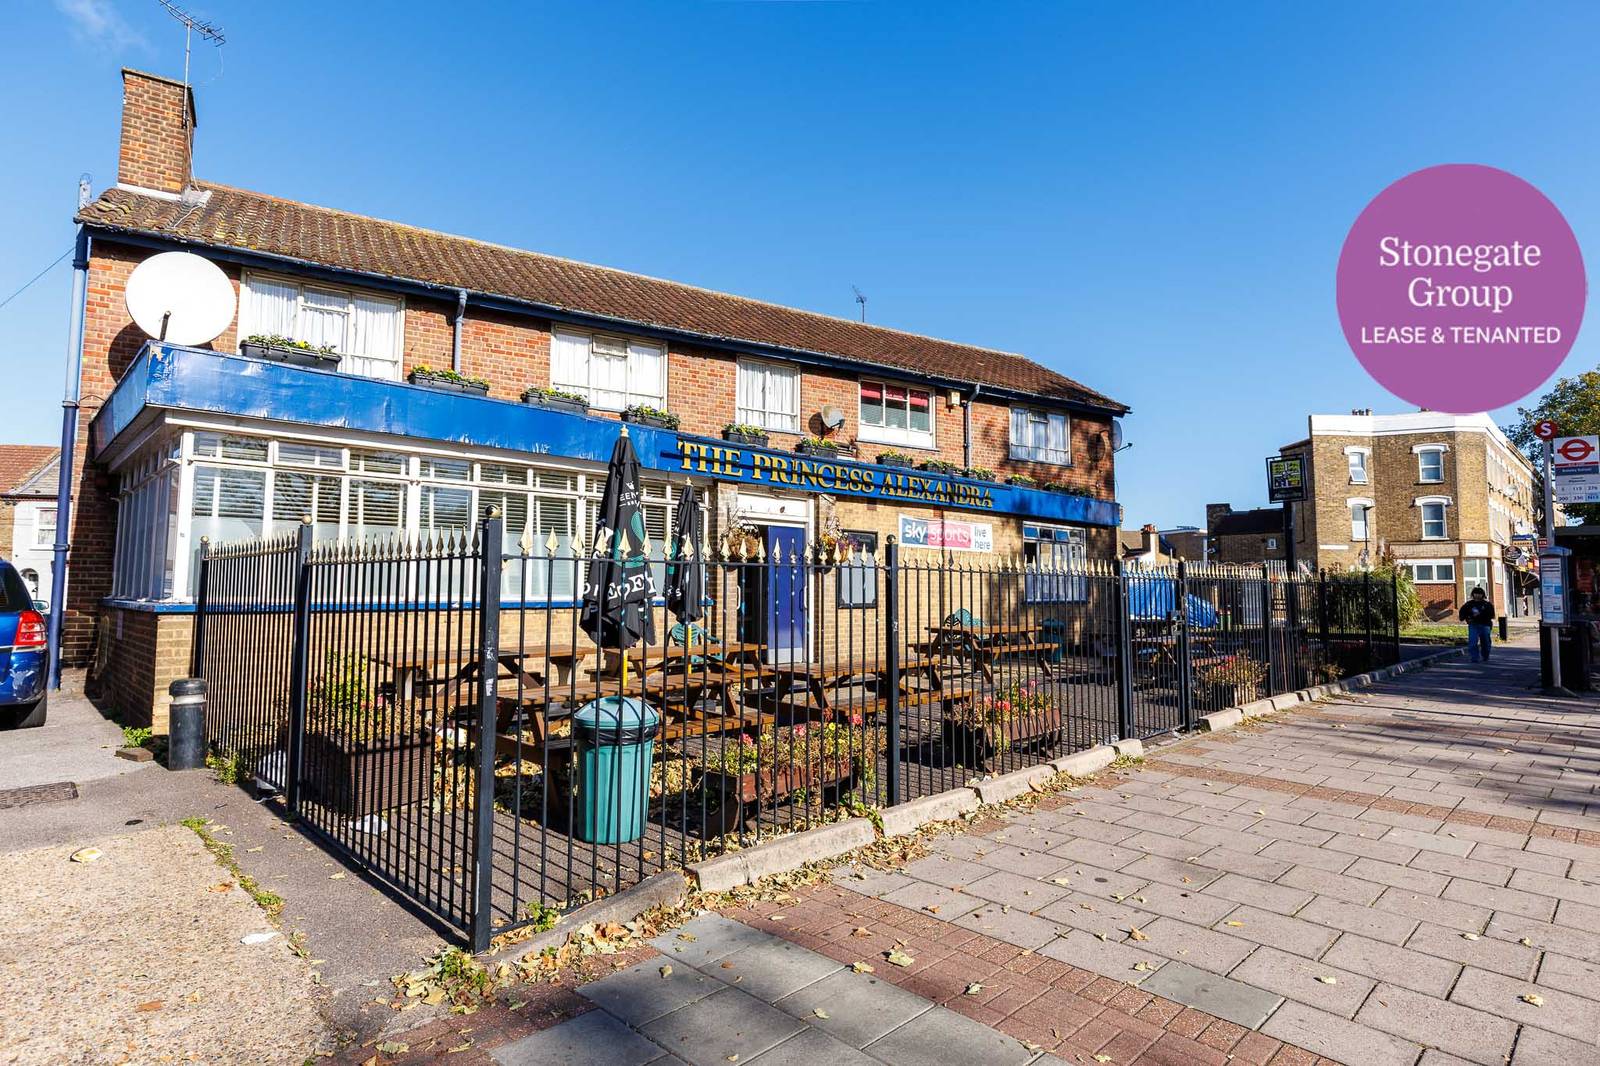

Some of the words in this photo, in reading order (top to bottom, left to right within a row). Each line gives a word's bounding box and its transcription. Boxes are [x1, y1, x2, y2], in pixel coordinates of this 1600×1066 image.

[1540, 422, 1552, 436] S
[677, 440, 743, 477] THE
[751, 452, 875, 493] PRINCESS
[880, 473, 994, 509] ALEXANDRA
[904, 521, 928, 543] sky
[928, 526, 971, 543] sports
[974, 526, 987, 538] live
[974, 539, 991, 550] here
